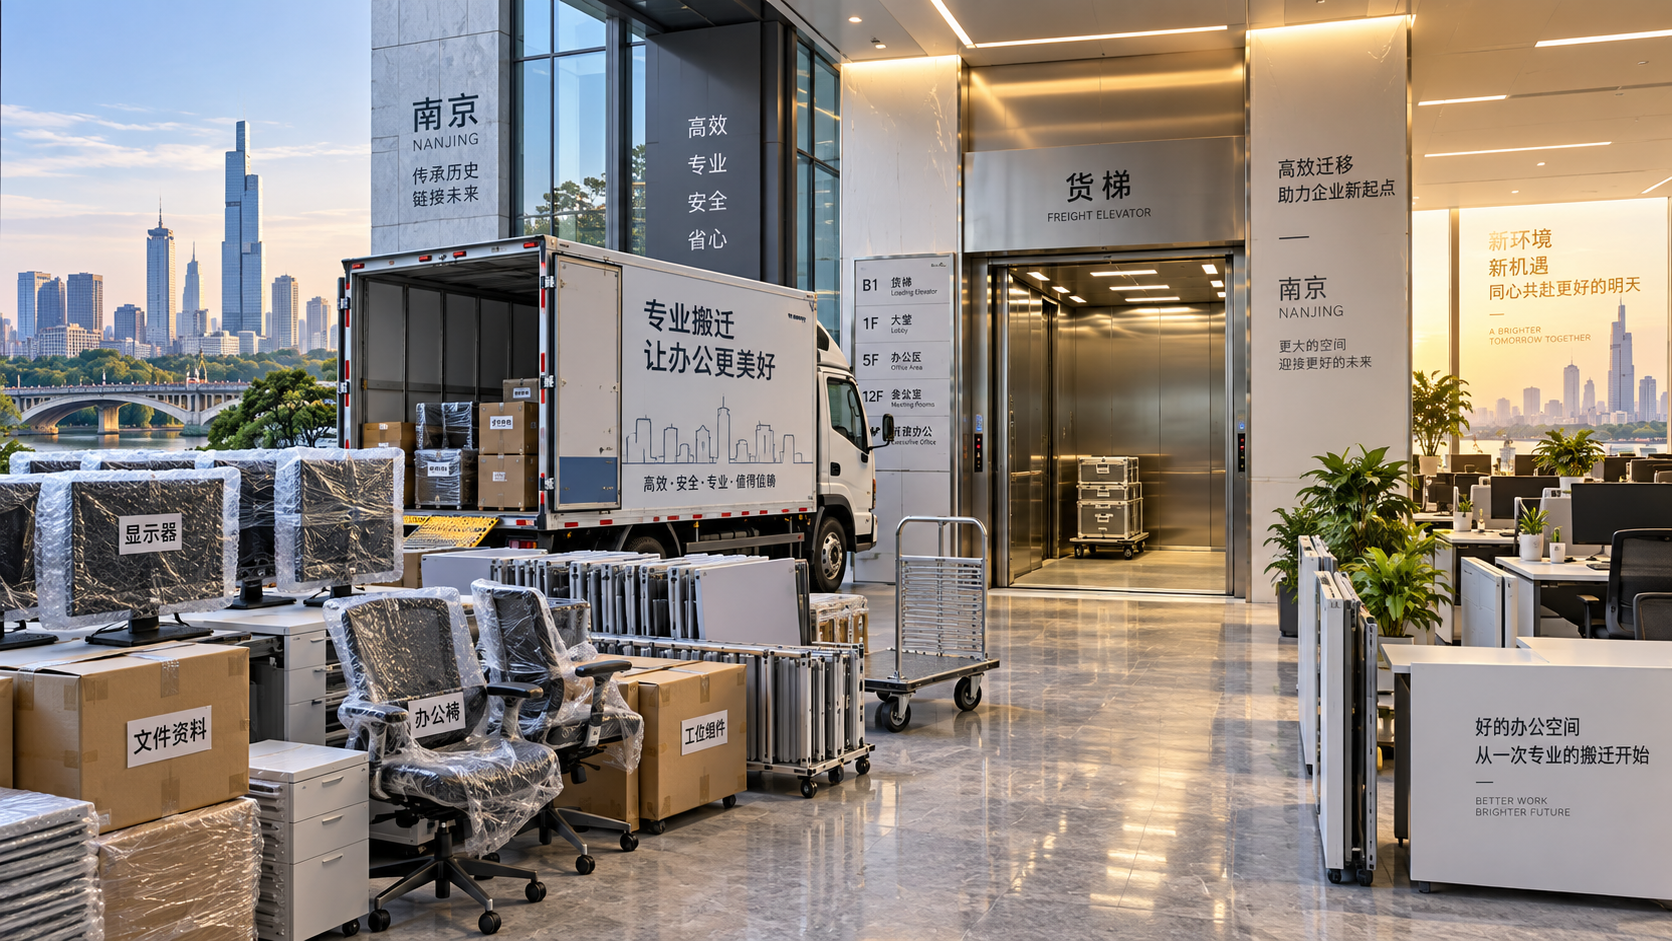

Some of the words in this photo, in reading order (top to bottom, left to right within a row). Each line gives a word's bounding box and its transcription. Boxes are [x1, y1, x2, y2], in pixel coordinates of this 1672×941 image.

[413, 93, 478, 132] 南京
[688, 115, 727, 138] 高效
[413, 133, 478, 151] NANJING
[412, 162, 478, 185] 传承历史
[688, 153, 726, 175] 专业
[413, 185, 478, 207] 链接未来
[1066, 170, 1130, 202] 货梯
[1278, 179, 1395, 203] 助力企业新起点
[688, 190, 727, 213] 安全
[1048, 211, 1093, 222] FREIGHT
[1097, 208, 1151, 219] ELEVATOR
[688, 229, 727, 250] 省心
[1489, 228, 1552, 251] 新环境
[1489, 256, 1548, 277] 新机遇
[863, 279, 877, 291] B1
[1279, 275, 1326, 301] 南京
[1489, 277, 1640, 300] 同心共赴更好的明天
[644, 299, 734, 339] 专业搬迁
[1280, 305, 1343, 318] NANJING
[864, 317, 878, 329] 1F
[1498, 326, 1541, 334] BRIGHTER
[1280, 338, 1346, 353] 更大的空间
[1489, 336, 1542, 345] TOMORROW
[1545, 334, 1591, 342] TOGETHER
[644, 340, 775, 380] 让办公更美好
[863, 354, 878, 366] 5F
[1279, 355, 1371, 370] 迎接更好的未来
[863, 391, 883, 402] 12F
[125, 522, 176, 544] 显示器
[134, 717, 206, 755] 文件资料
[685, 719, 725, 745] 工位组件
[1476, 717, 1579, 736] 好的办公空间
[1476, 745, 1649, 764] 从一次专业的搬迁开始
[1476, 797, 1513, 805] BETTER
[1517, 797, 1547, 805] WORK
[1476, 808, 1526, 816] BRIGHTER
[1531, 808, 1570, 816] FUTURE
